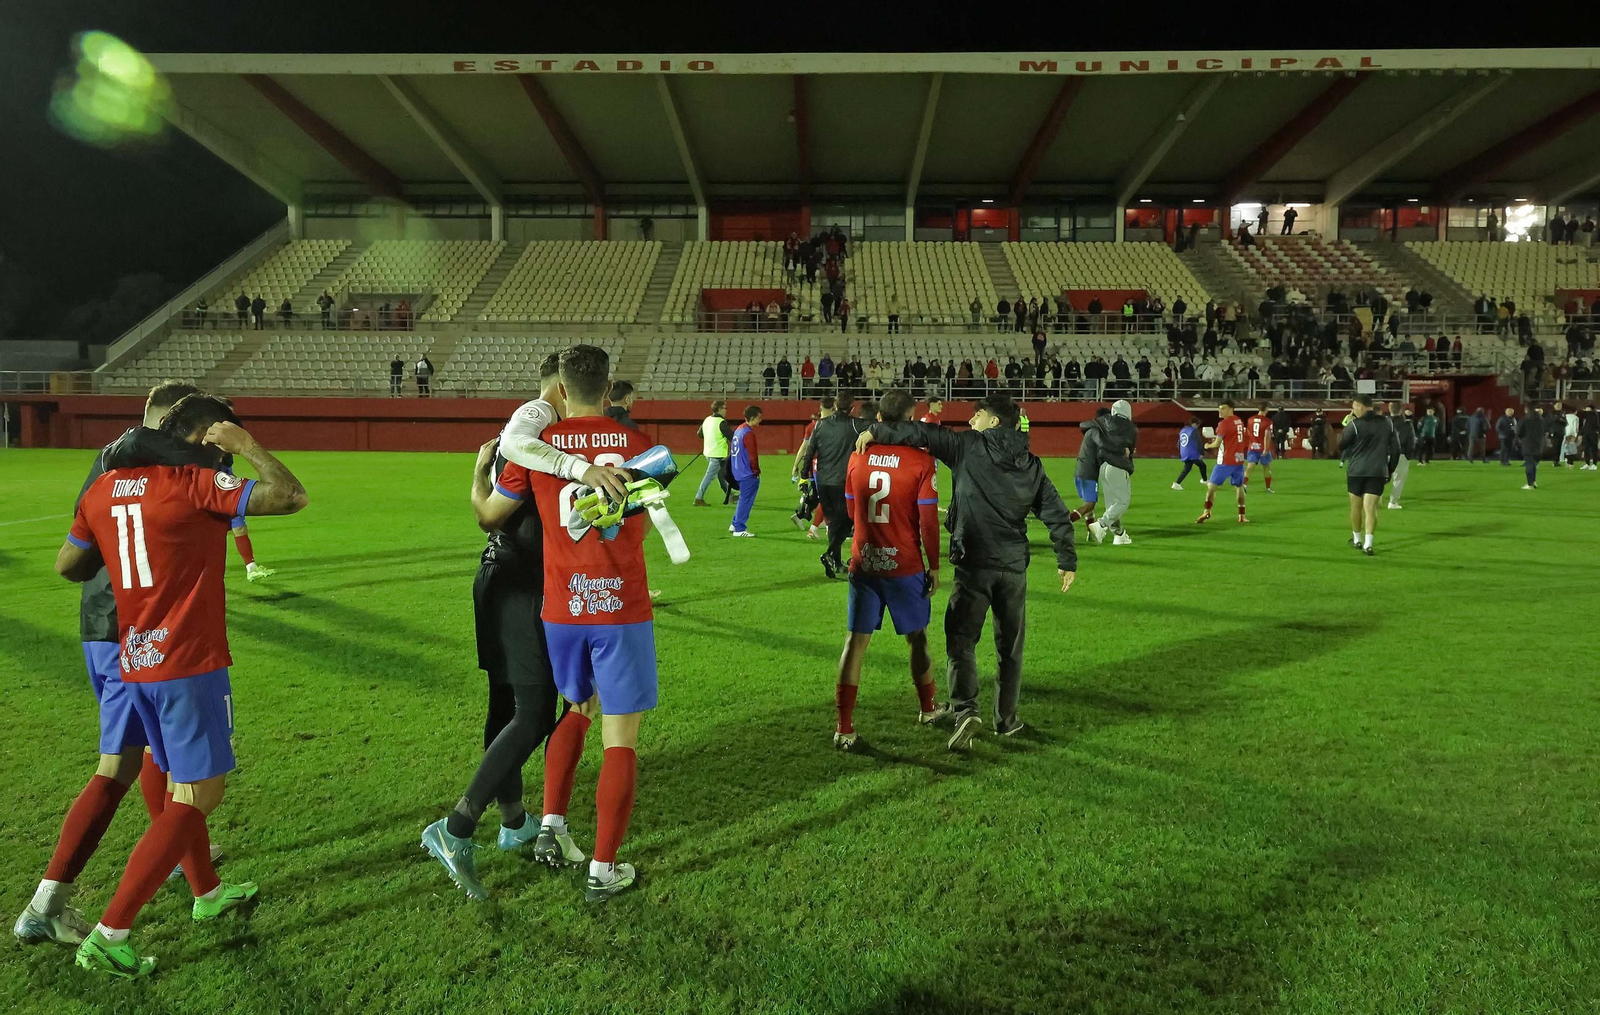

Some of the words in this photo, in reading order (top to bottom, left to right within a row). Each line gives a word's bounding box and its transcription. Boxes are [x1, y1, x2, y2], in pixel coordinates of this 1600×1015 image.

[453, 59, 715, 72] ESTADIO
[1019, 56, 1383, 72] MUNICIPAL
[1253, 422, 1260, 437] 9
[551, 433, 588, 449] ALEIX
[591, 432, 628, 448] COCH
[867, 453, 900, 469] ROLDÁN
[111, 475, 148, 498] TOMÁS
[867, 470, 891, 524] 2
[110, 502, 154, 589] 11
[586, 593, 624, 615] Gusta
